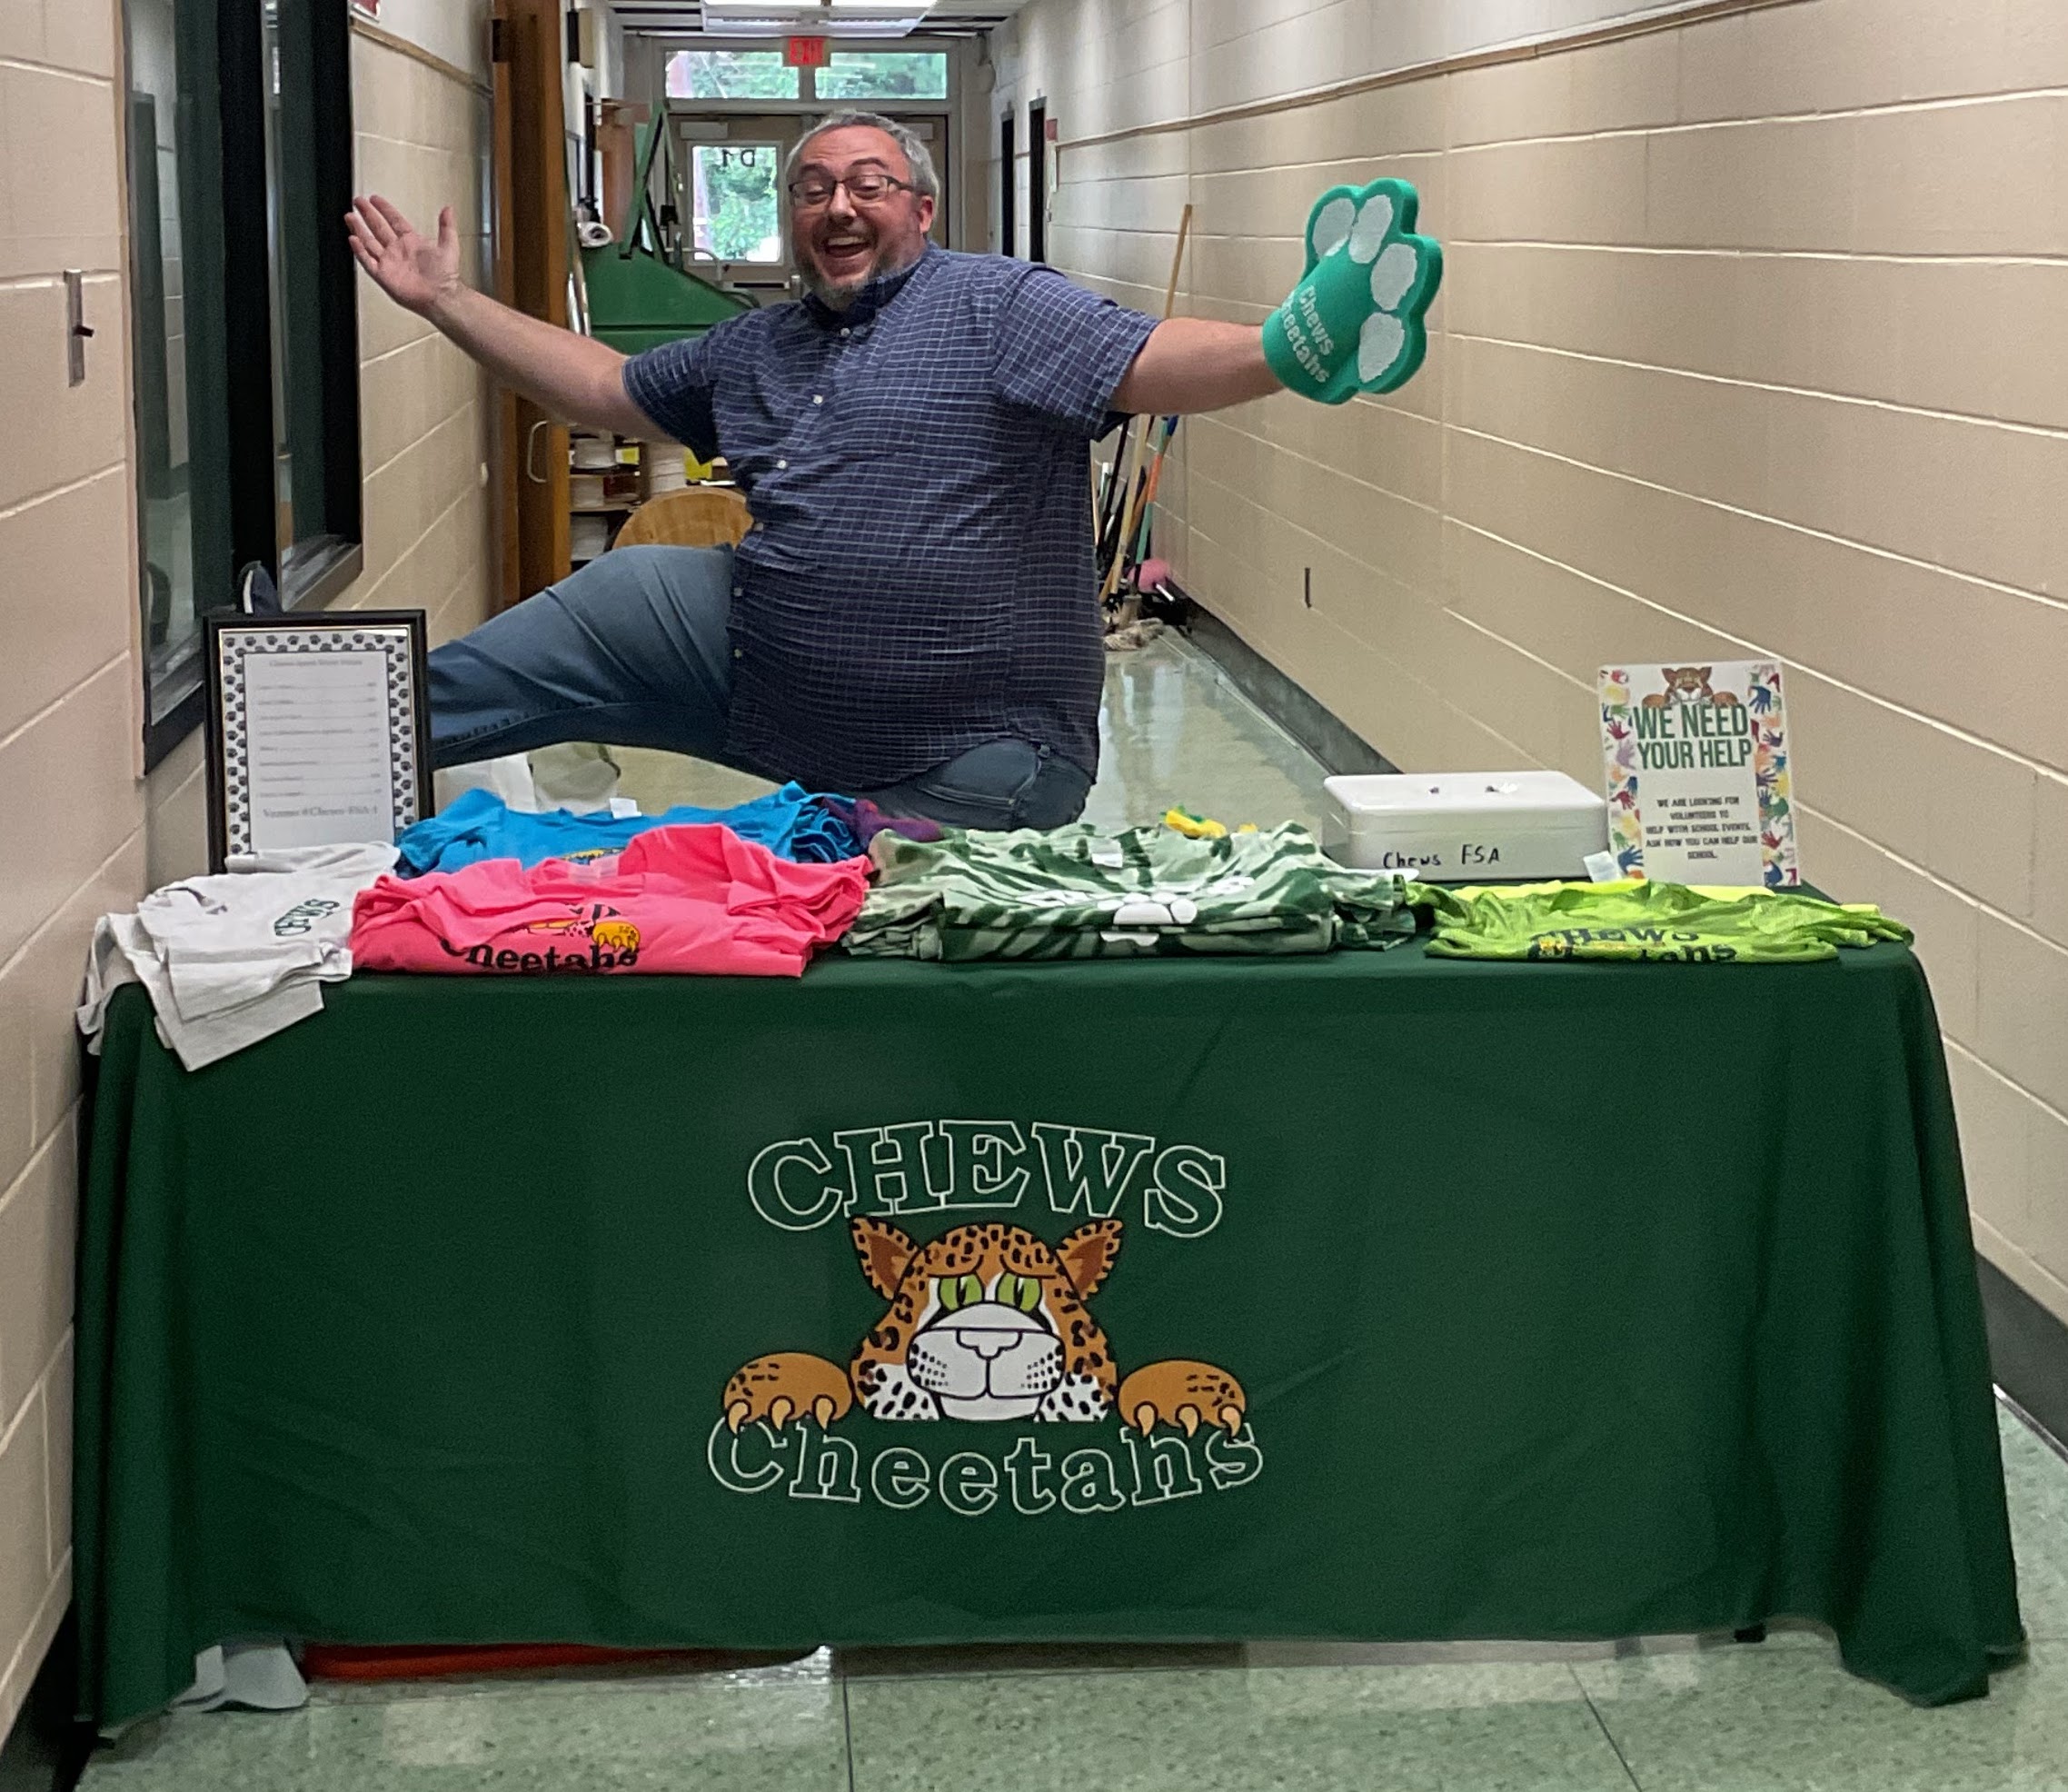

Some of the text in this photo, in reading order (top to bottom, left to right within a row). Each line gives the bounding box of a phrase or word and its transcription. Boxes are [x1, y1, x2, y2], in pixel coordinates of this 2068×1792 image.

[789, 35, 825, 65] EXIT
[1299, 285, 1334, 355] Chews
[1633, 703, 1748, 739] WE NEED
[1637, 739, 1752, 769] YOUR HELP
[1671, 799, 1686, 807] ARE
[1383, 843, 1500, 869] Chews FSA
[1703, 837, 1719, 845] CAN
[747, 1120, 1227, 1239] CHEWS
[707, 1416, 1264, 1516] Cheetahs
